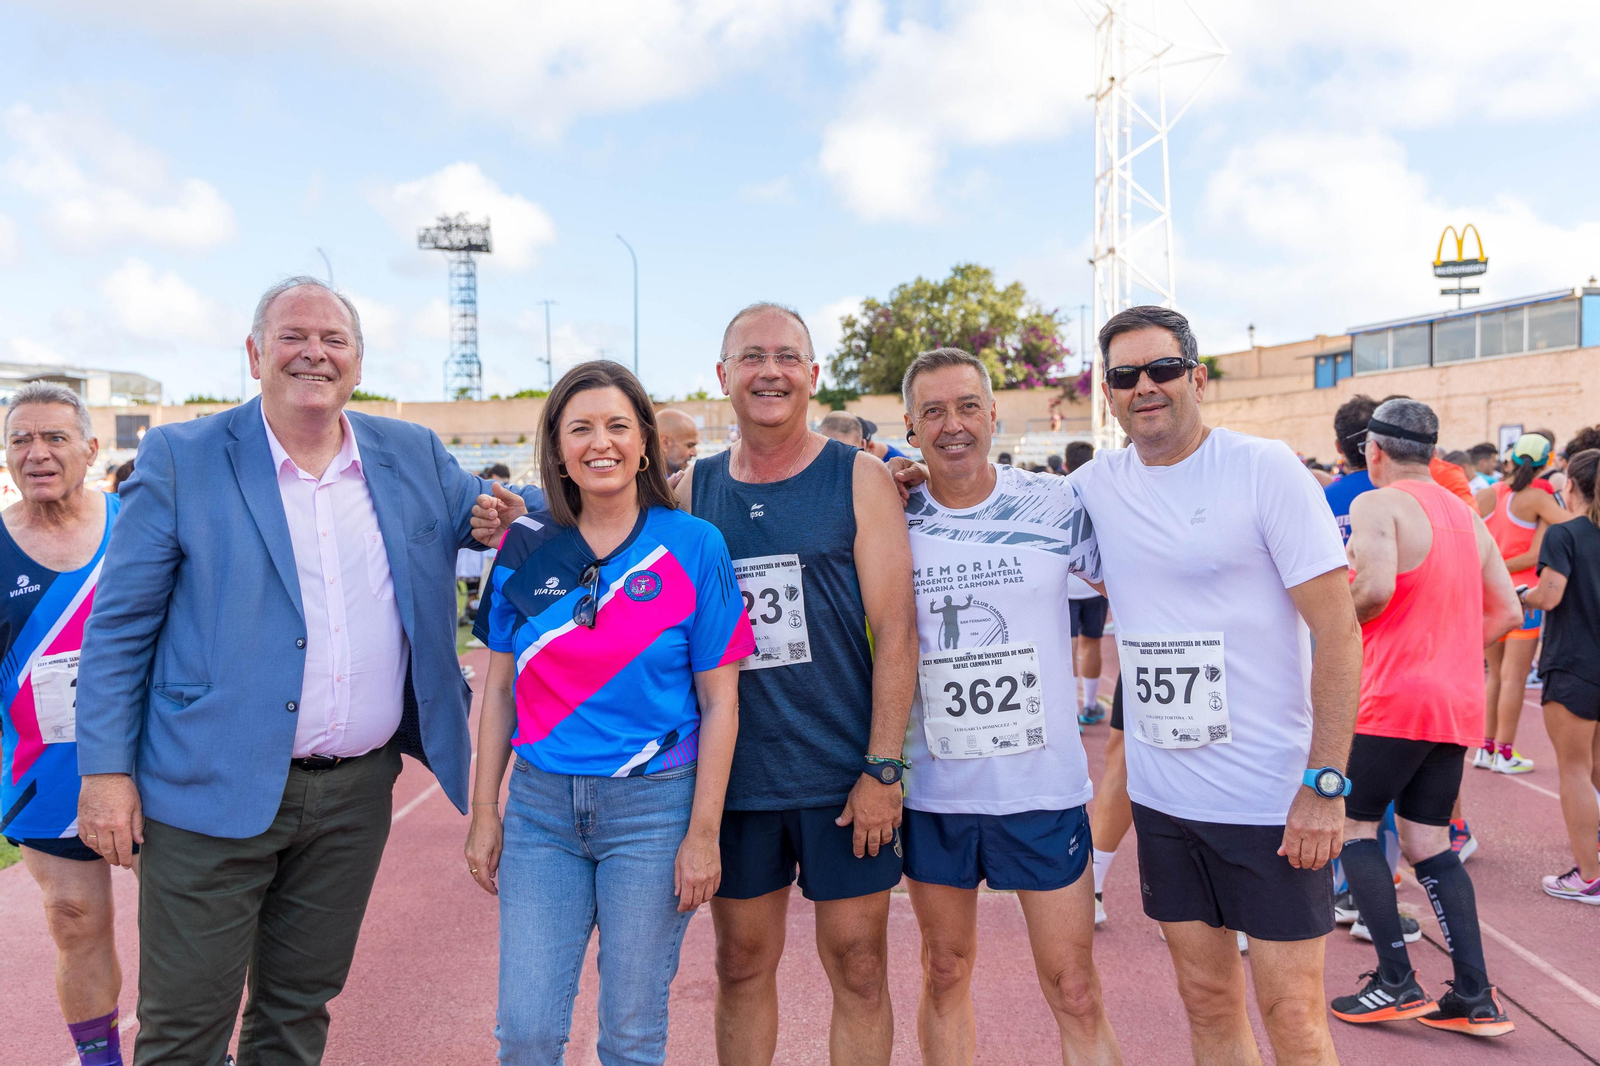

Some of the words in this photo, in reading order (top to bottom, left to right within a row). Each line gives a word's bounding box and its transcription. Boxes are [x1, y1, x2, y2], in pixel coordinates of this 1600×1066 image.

[1190, 516, 1206, 526] ipso
[749, 563, 774, 571] INFANTERÍA
[913, 557, 1021, 578] MEMORIAL
[972, 568, 1022, 580] INFANTERIA
[10, 584, 41, 598] VIATOR
[923, 584, 954, 594] MARINA
[958, 580, 1000, 589] CARMONA
[973, 600, 989, 608] CLUB
[990, 605, 1008, 630] CARMONA
[985, 650, 1010, 659] INFANTERÍA
[1136, 666, 1200, 704] 557
[943, 675, 1021, 717] 362
